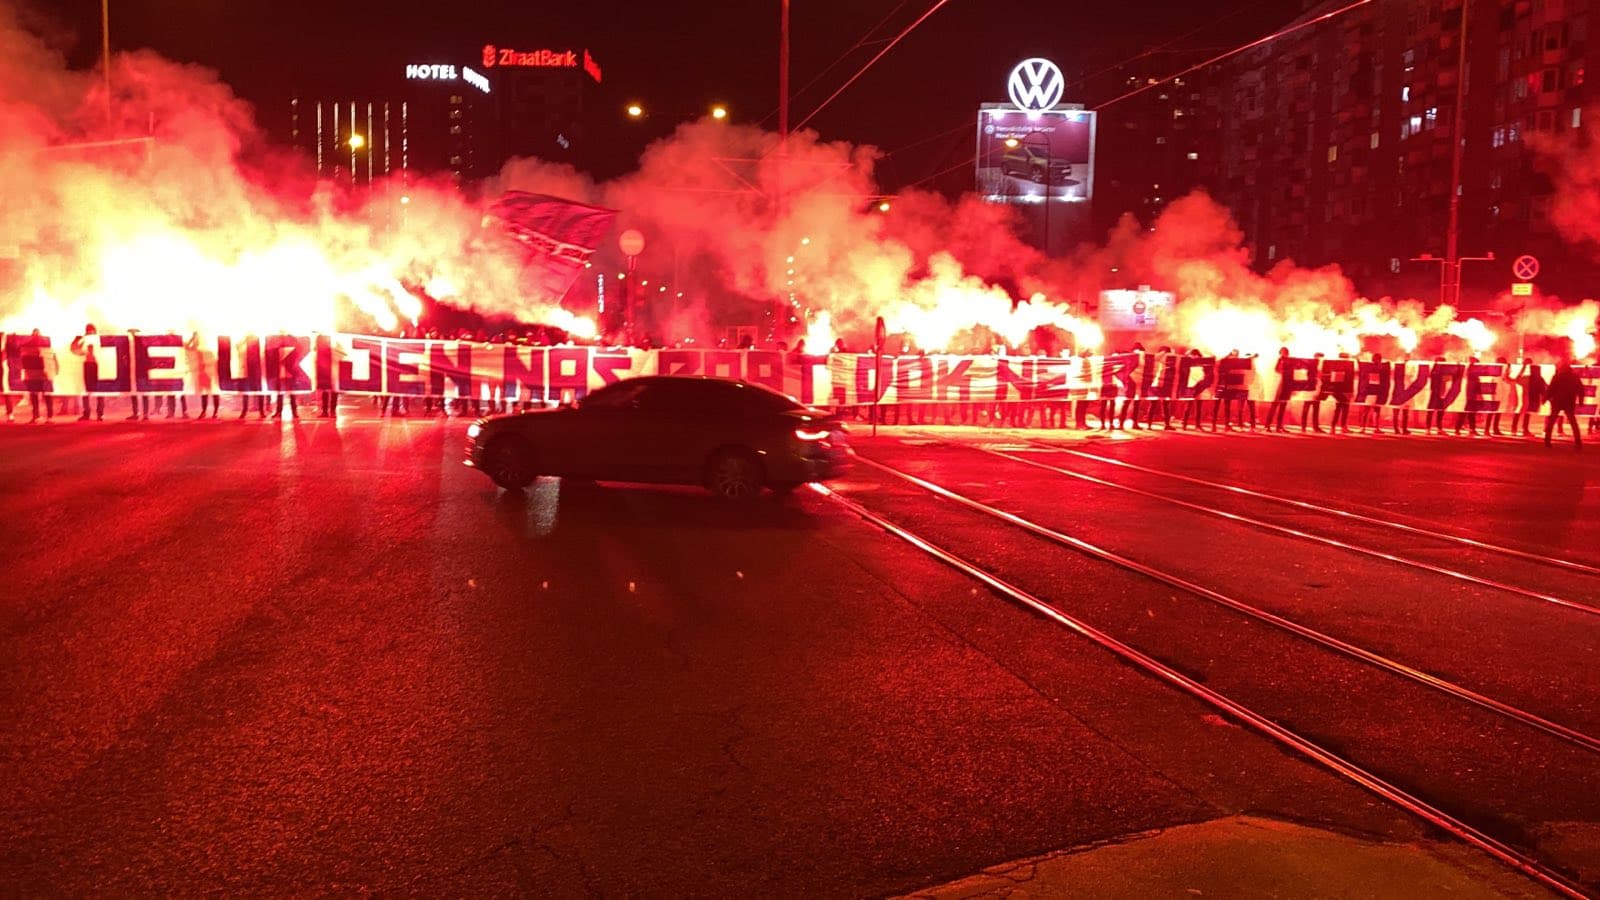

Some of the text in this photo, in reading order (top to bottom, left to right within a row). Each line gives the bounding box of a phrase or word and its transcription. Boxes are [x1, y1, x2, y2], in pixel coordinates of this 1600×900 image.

[499, 50, 577, 67] ZiraatBank
[406, 64, 458, 79] HOTEL
[84, 334, 184, 392] JE
[216, 334, 472, 398] UBIJEN
[996, 358, 1073, 401] NE
[1101, 352, 1252, 399] BUDE
[1280, 357, 1502, 411] PRAVDE
